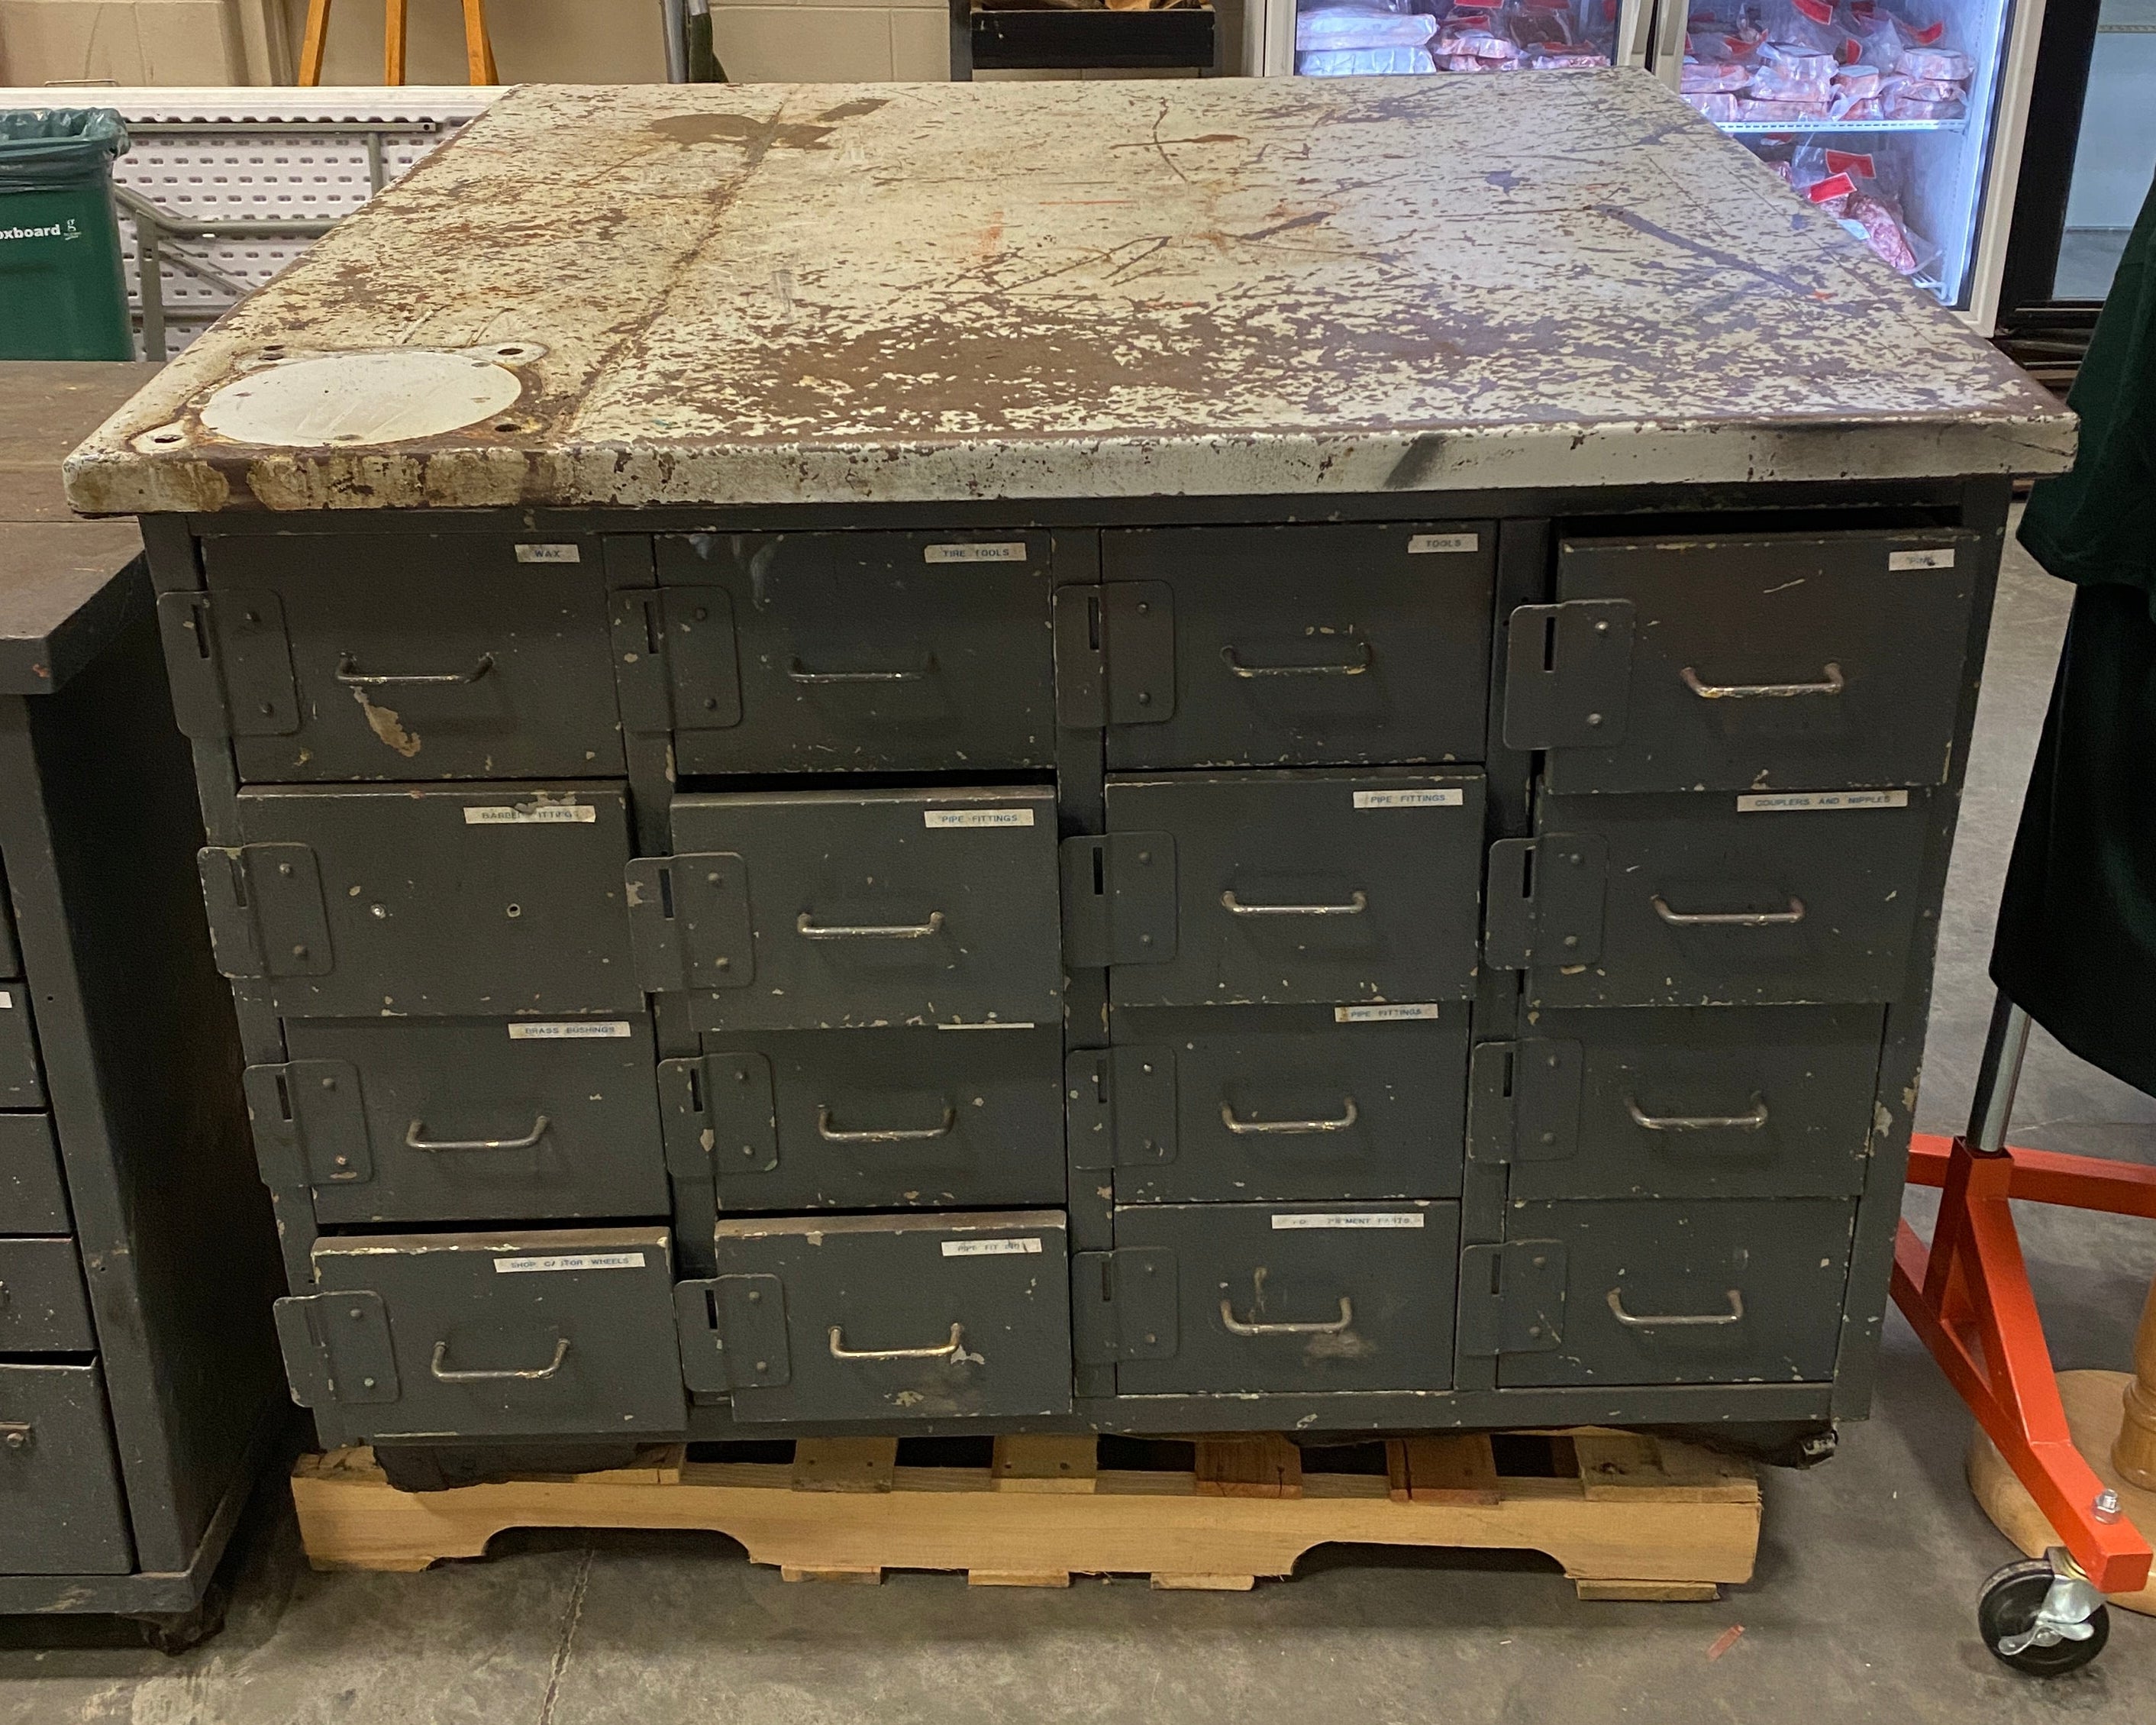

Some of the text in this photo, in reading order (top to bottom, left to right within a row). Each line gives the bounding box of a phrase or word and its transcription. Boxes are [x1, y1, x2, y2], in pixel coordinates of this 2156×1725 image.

[1426, 539, 1461, 548] TOOLS
[975, 548, 1009, 557] TOOLS
[1370, 794, 1445, 803] PIPE FITTINGS
[1755, 798, 1809, 807] COUPLERS
[1848, 796, 1891, 804] NIPPLES
[941, 814, 1018, 823] PIPE FITTINGS
[525, 1026, 615, 1035] BRASS BUSHINGS
